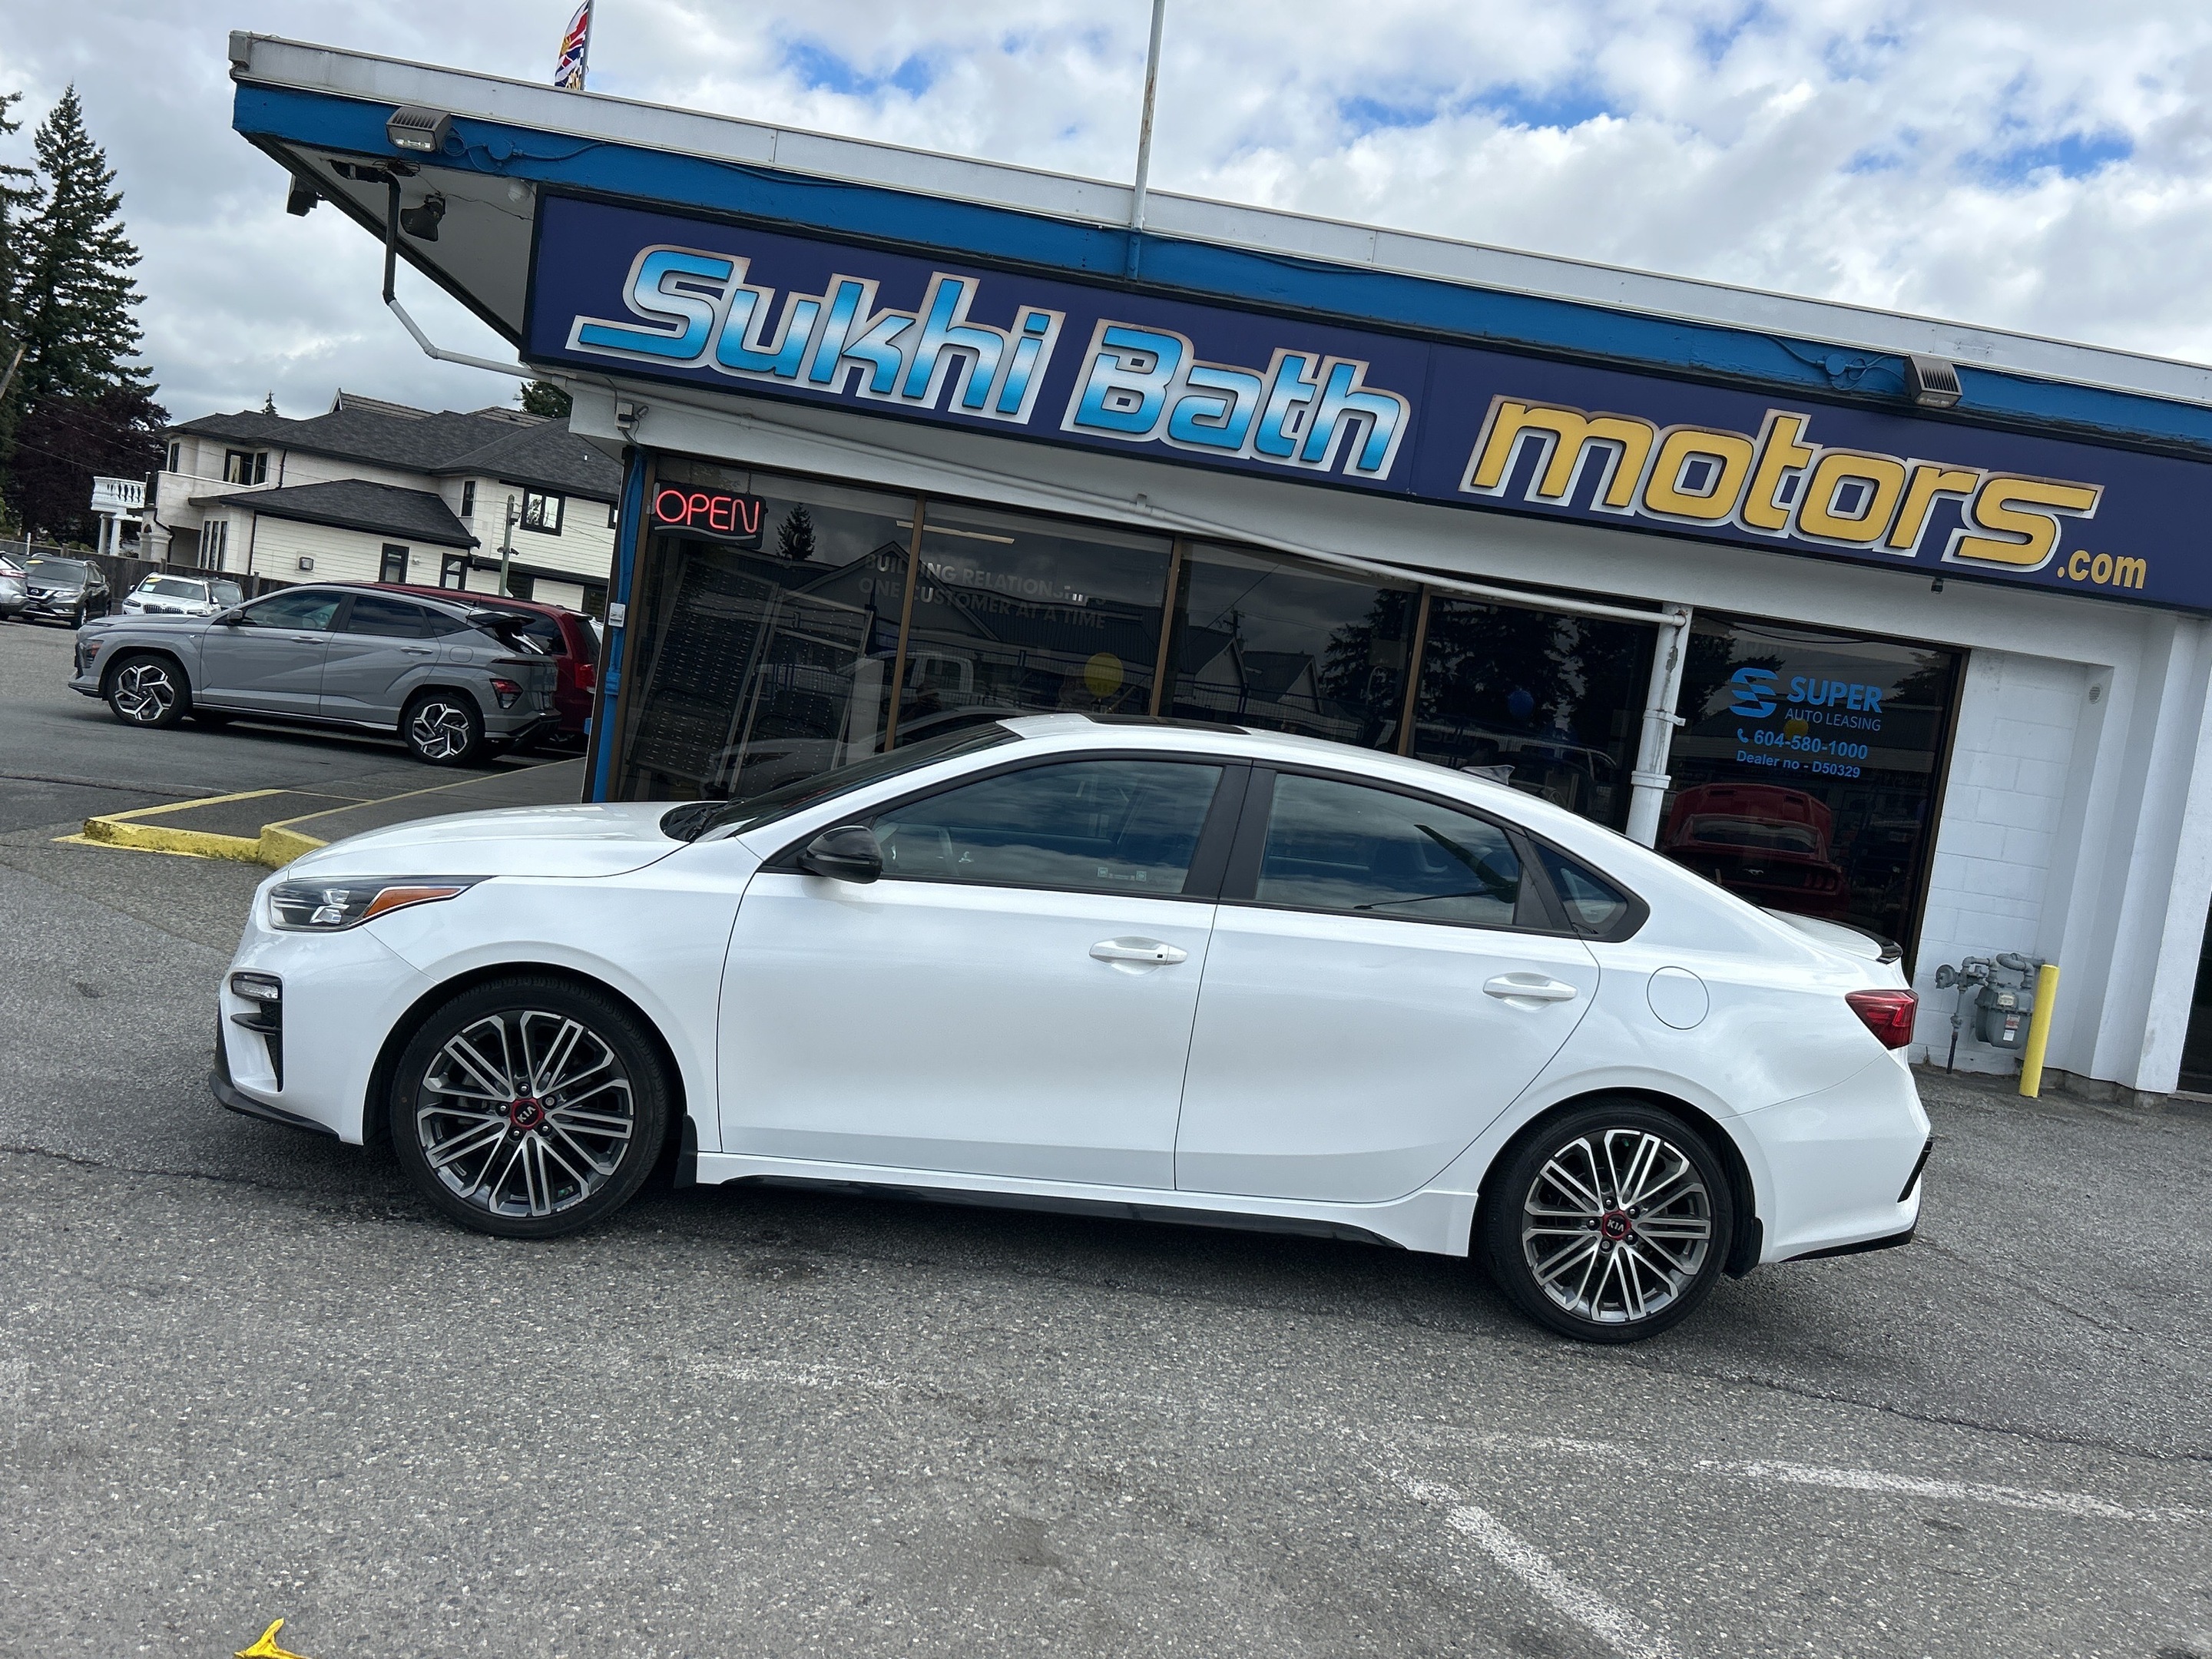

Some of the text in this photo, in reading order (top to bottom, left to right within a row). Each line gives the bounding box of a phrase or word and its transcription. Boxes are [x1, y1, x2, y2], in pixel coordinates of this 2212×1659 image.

[566, 244, 2147, 589] Sukhi Bath motors .com
[655, 489, 760, 534] OPEN
[865, 553, 958, 583] BUILING
[859, 577, 1106, 629] ONE USTOMER AT A TIME
[1786, 675, 1883, 713] SUPER
[1784, 707, 1882, 731] AUTO LEASING
[1753, 729, 1869, 760] 604-580-1000
[1736, 750, 1780, 767] Dealer
[1783, 758, 1800, 770] no
[1812, 760, 1862, 778] D50329
[517, 1105, 537, 1123] KIA
[1607, 1219, 1624, 1232] KIA
